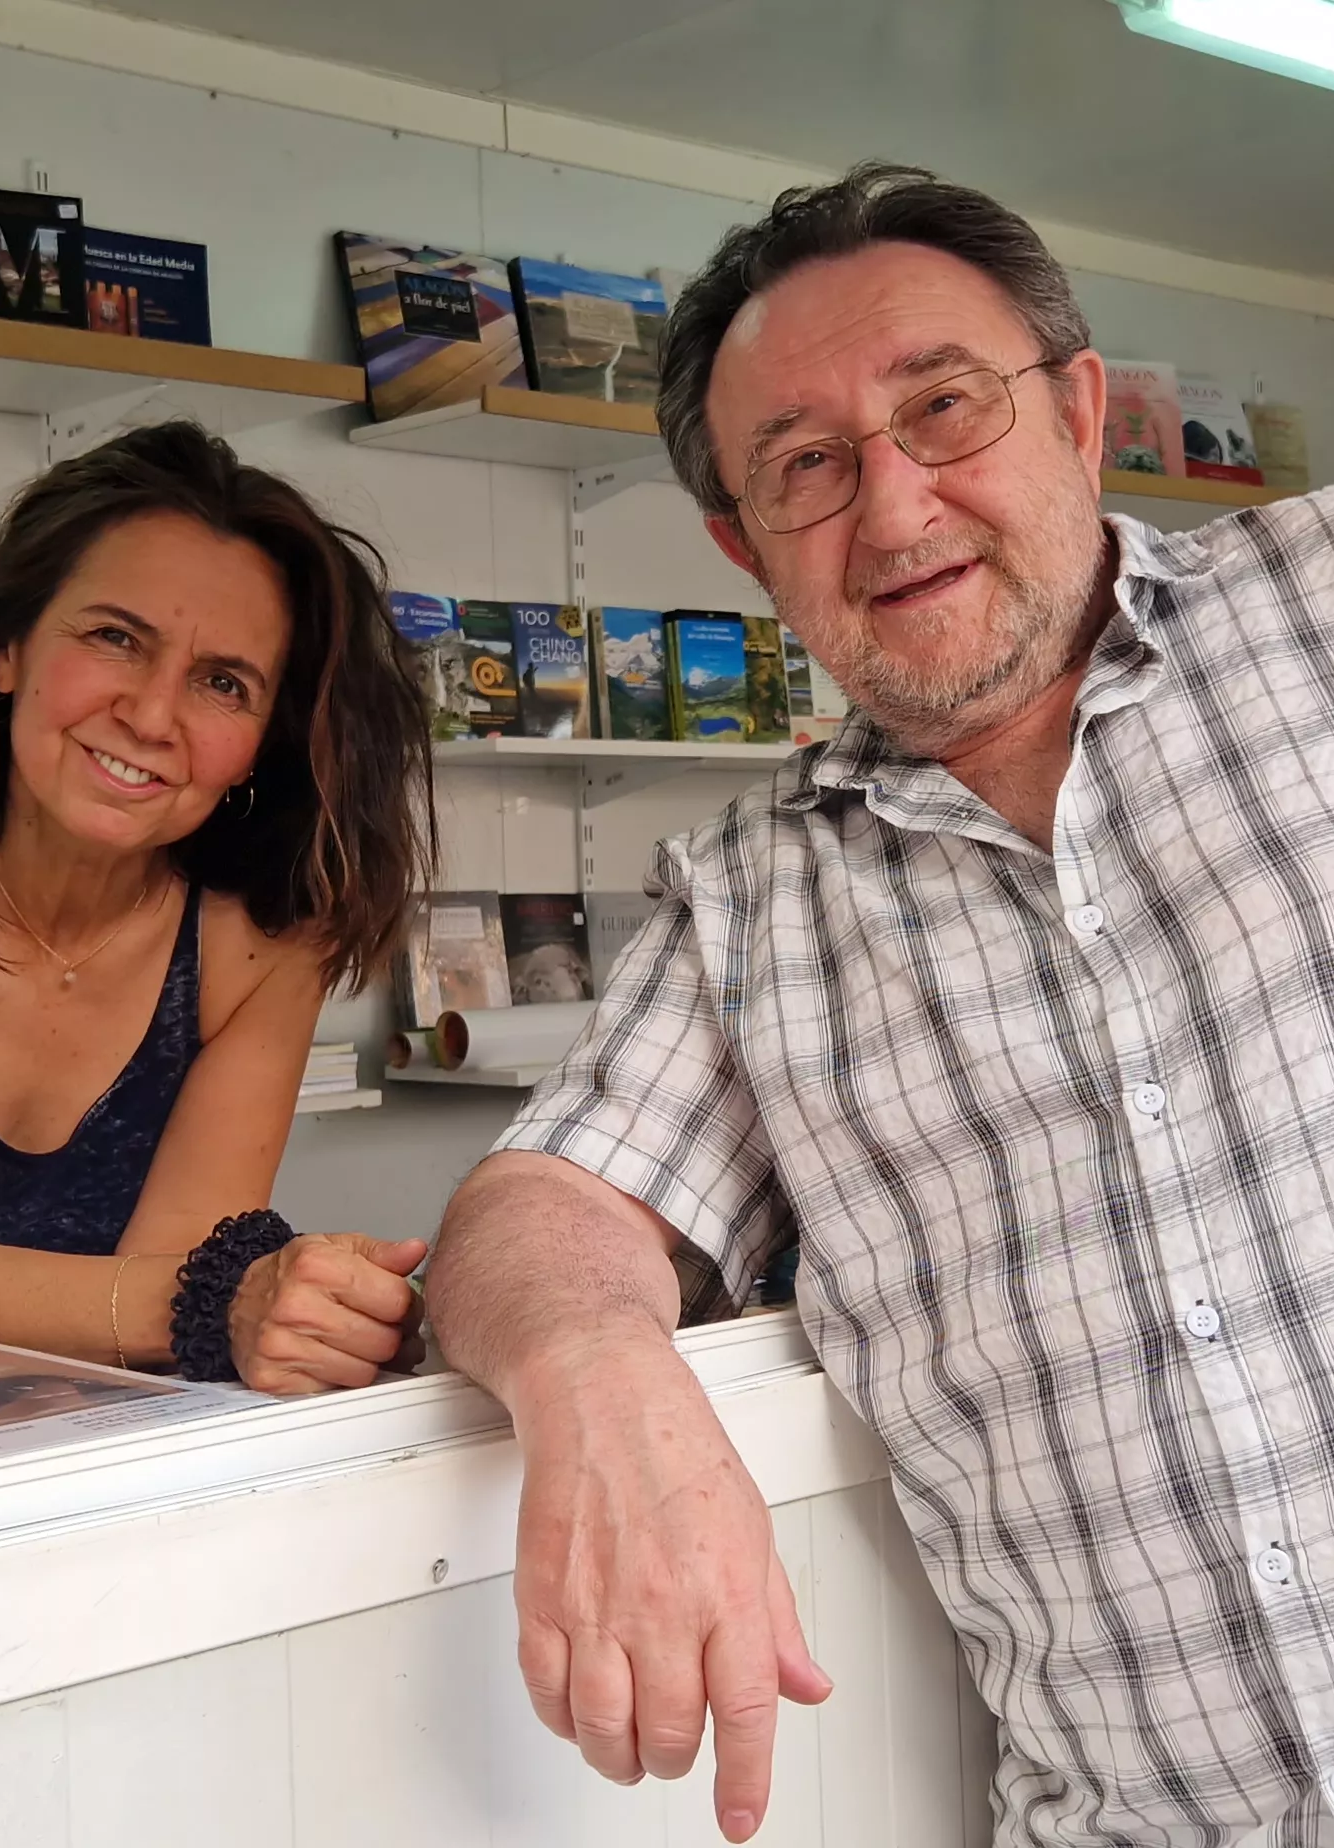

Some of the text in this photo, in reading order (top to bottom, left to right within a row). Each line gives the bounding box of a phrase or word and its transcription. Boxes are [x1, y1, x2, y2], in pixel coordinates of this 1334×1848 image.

[165, 257, 196, 272] Media
[413, 293, 433, 308] flor
[435, 297, 451, 311] de
[452, 300, 472, 315] piel
[517, 610, 550, 626] 100
[529, 637, 577, 652] CHINO
[530, 650, 582, 665] CHANO
[601, 915, 647, 932] GUERR
